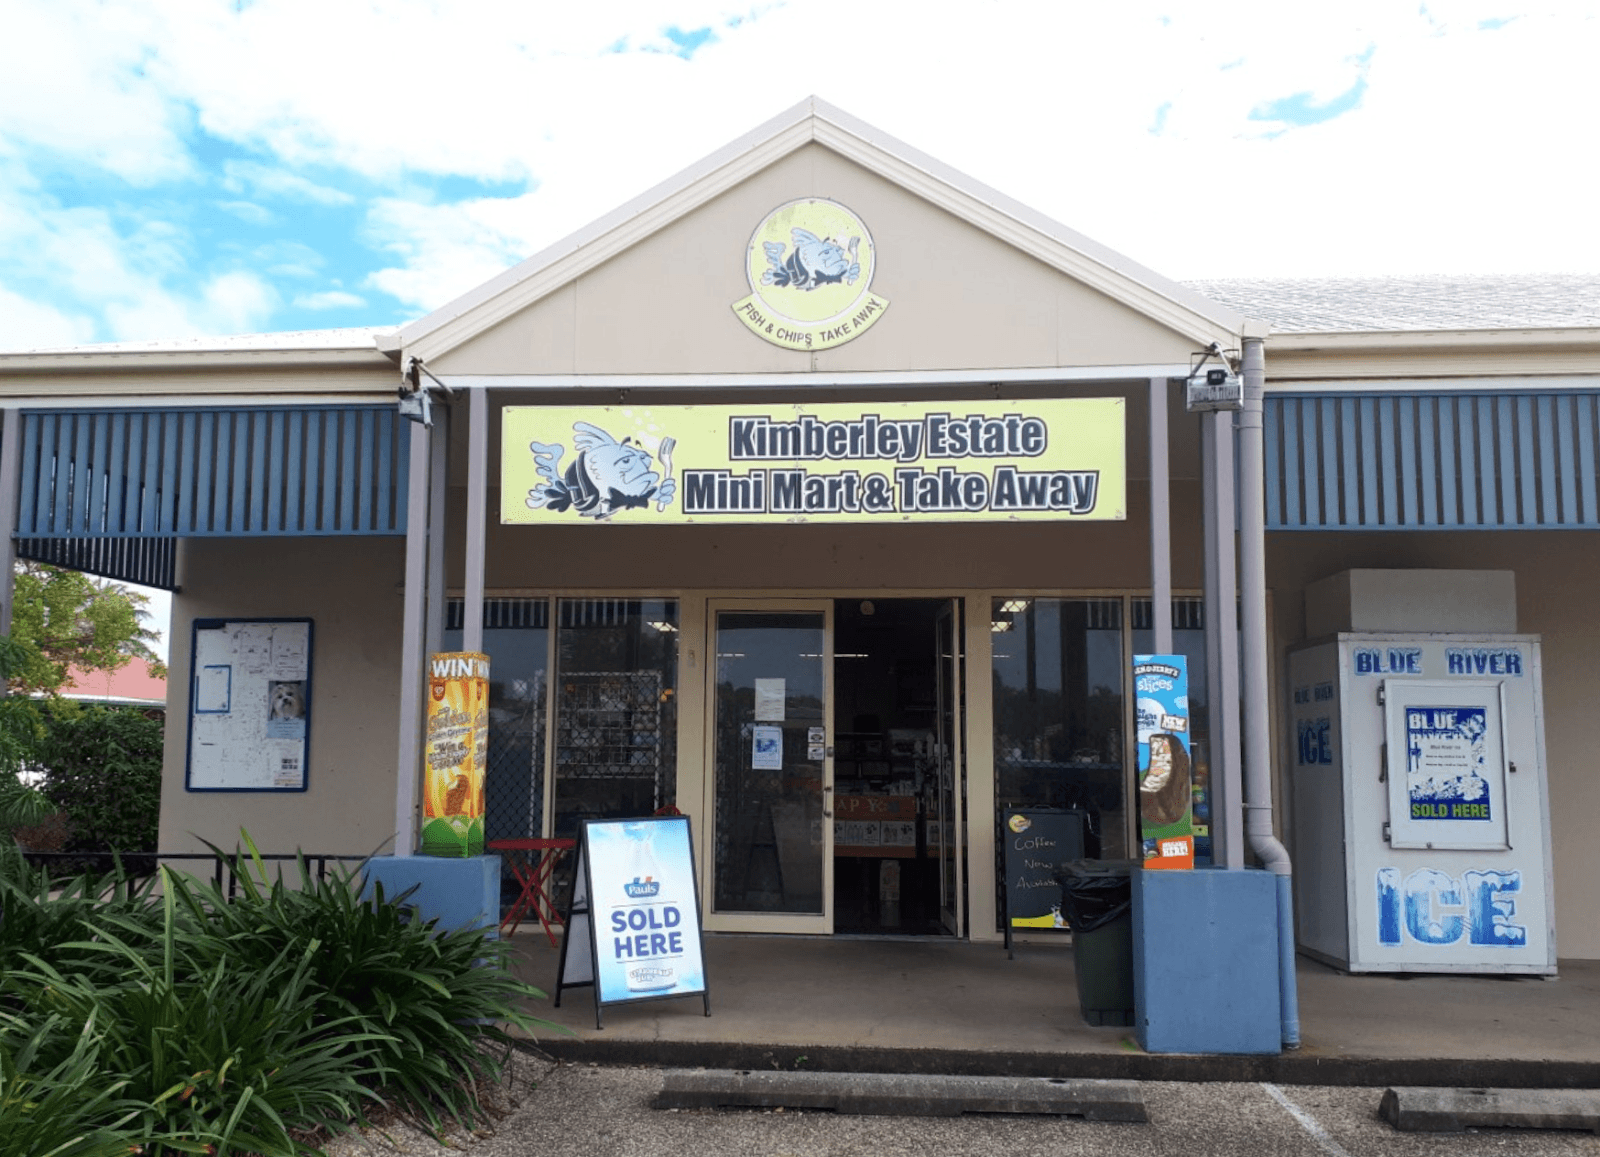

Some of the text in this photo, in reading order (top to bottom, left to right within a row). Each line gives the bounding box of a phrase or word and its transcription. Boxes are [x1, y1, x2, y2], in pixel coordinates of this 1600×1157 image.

[741, 298, 881, 343] FISH & CHIPS TAKE AWAY
[729, 413, 1048, 463] Kimberley Estate
[682, 466, 1100, 514] Mini Mart & Take Away
[432, 659, 474, 678] WIN
[1354, 648, 1523, 677] BLUE RIVER
[1409, 710, 1458, 730] BLUE
[1297, 718, 1332, 765] ICE
[1411, 803, 1489, 818] SOLD HERE
[1014, 837, 1057, 851] Coffee
[1024, 858, 1053, 869] Now
[628, 885, 657, 896] Pauls
[611, 906, 681, 933] SOLD
[1376, 866, 1528, 948] ICE
[614, 931, 684, 959] HERE
